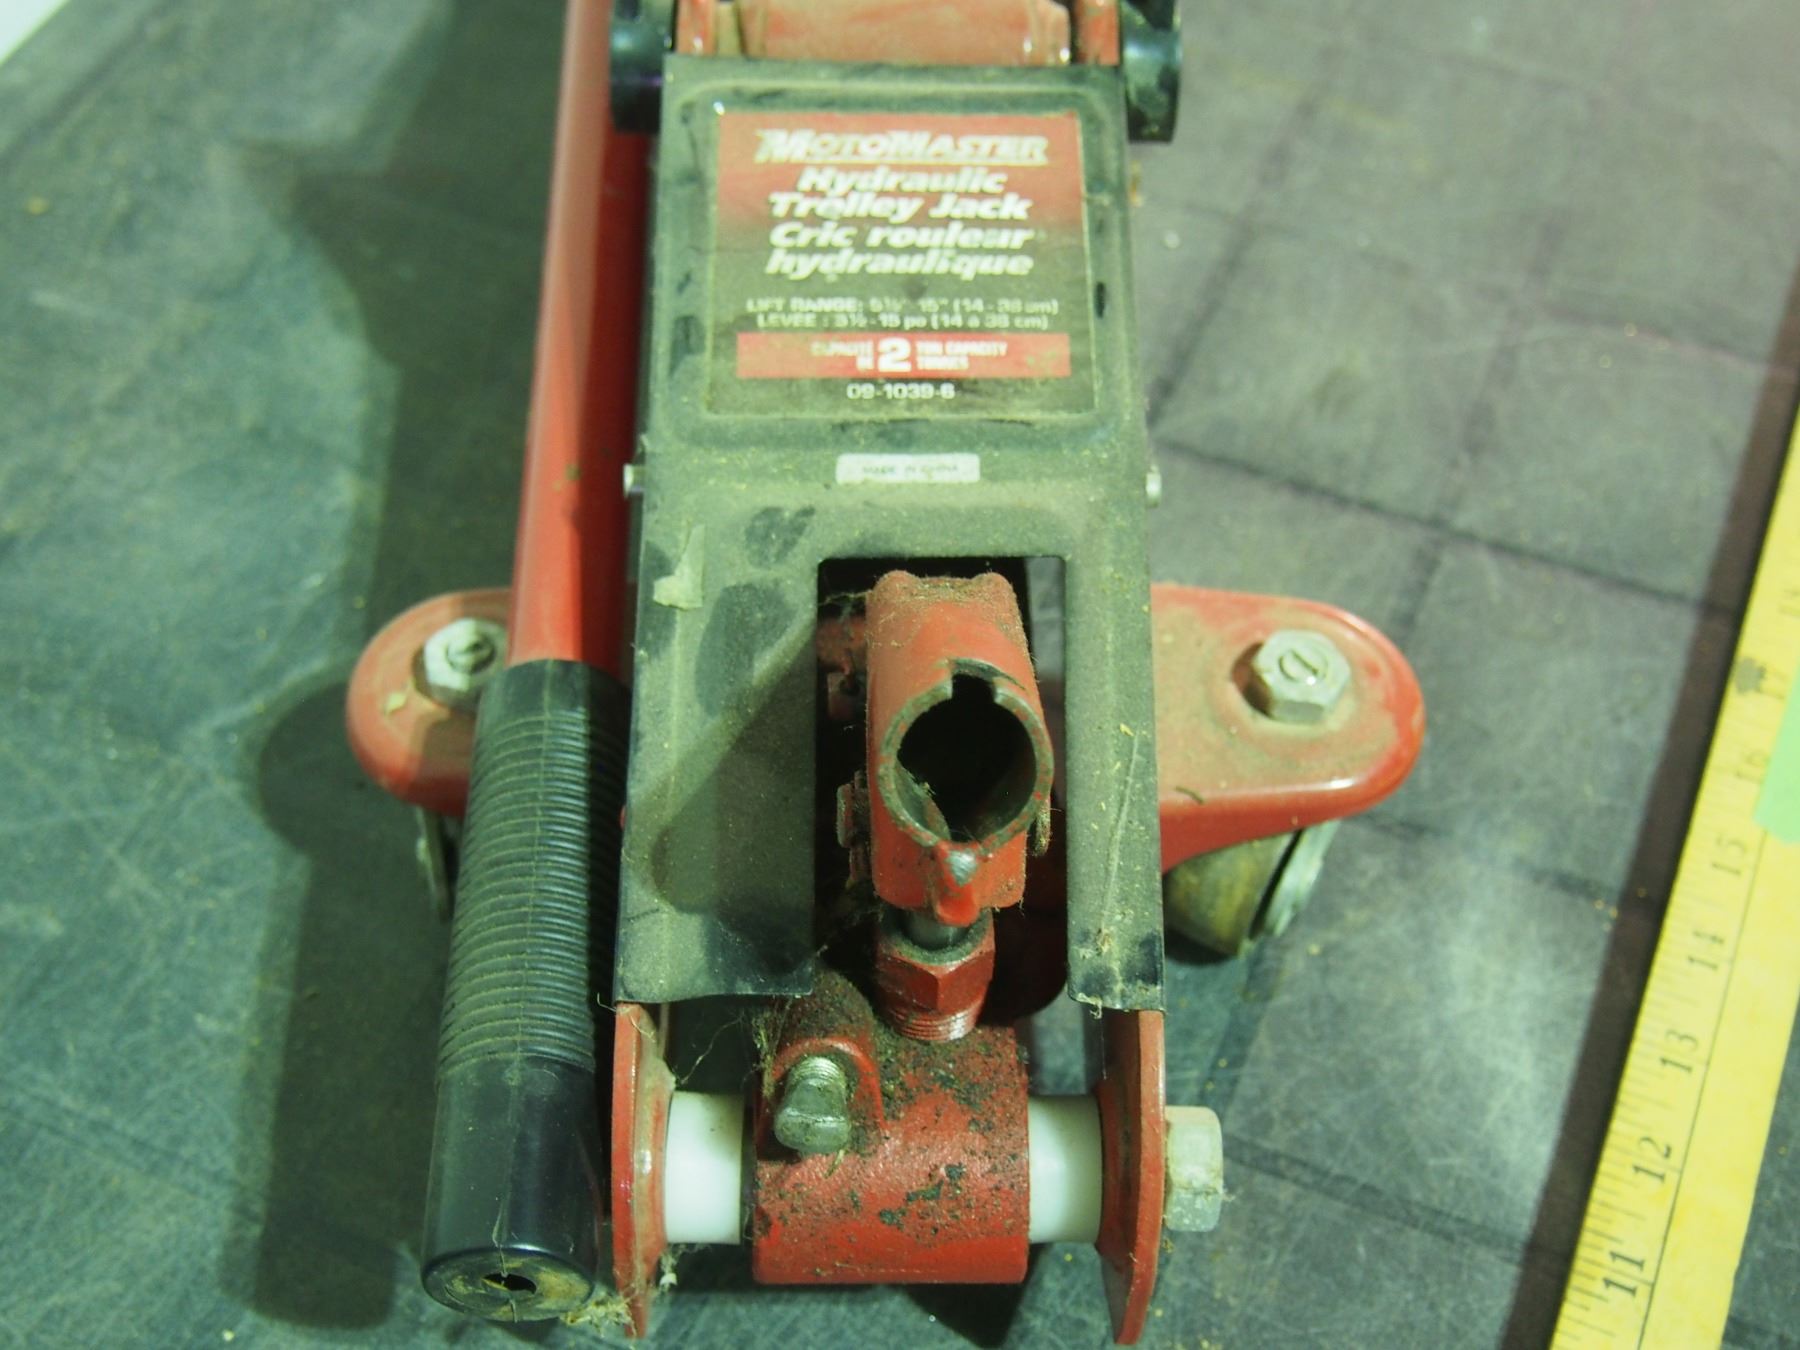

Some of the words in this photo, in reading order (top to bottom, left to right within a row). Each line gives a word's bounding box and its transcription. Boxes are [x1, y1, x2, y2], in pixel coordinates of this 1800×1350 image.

[797, 167, 1008, 195] Hydraulic
[769, 192, 923, 223] Trolley
[929, 193, 1032, 220] Jack
[770, 221, 857, 248] Cric
[865, 223, 1036, 249] rouleur
[765, 248, 1034, 281] hydraulique
[877, 338, 912, 373] 2
[1659, 1028, 1699, 1073] 13
[1632, 1136, 1672, 1182] 12
[1602, 1250, 1646, 1297] 11
